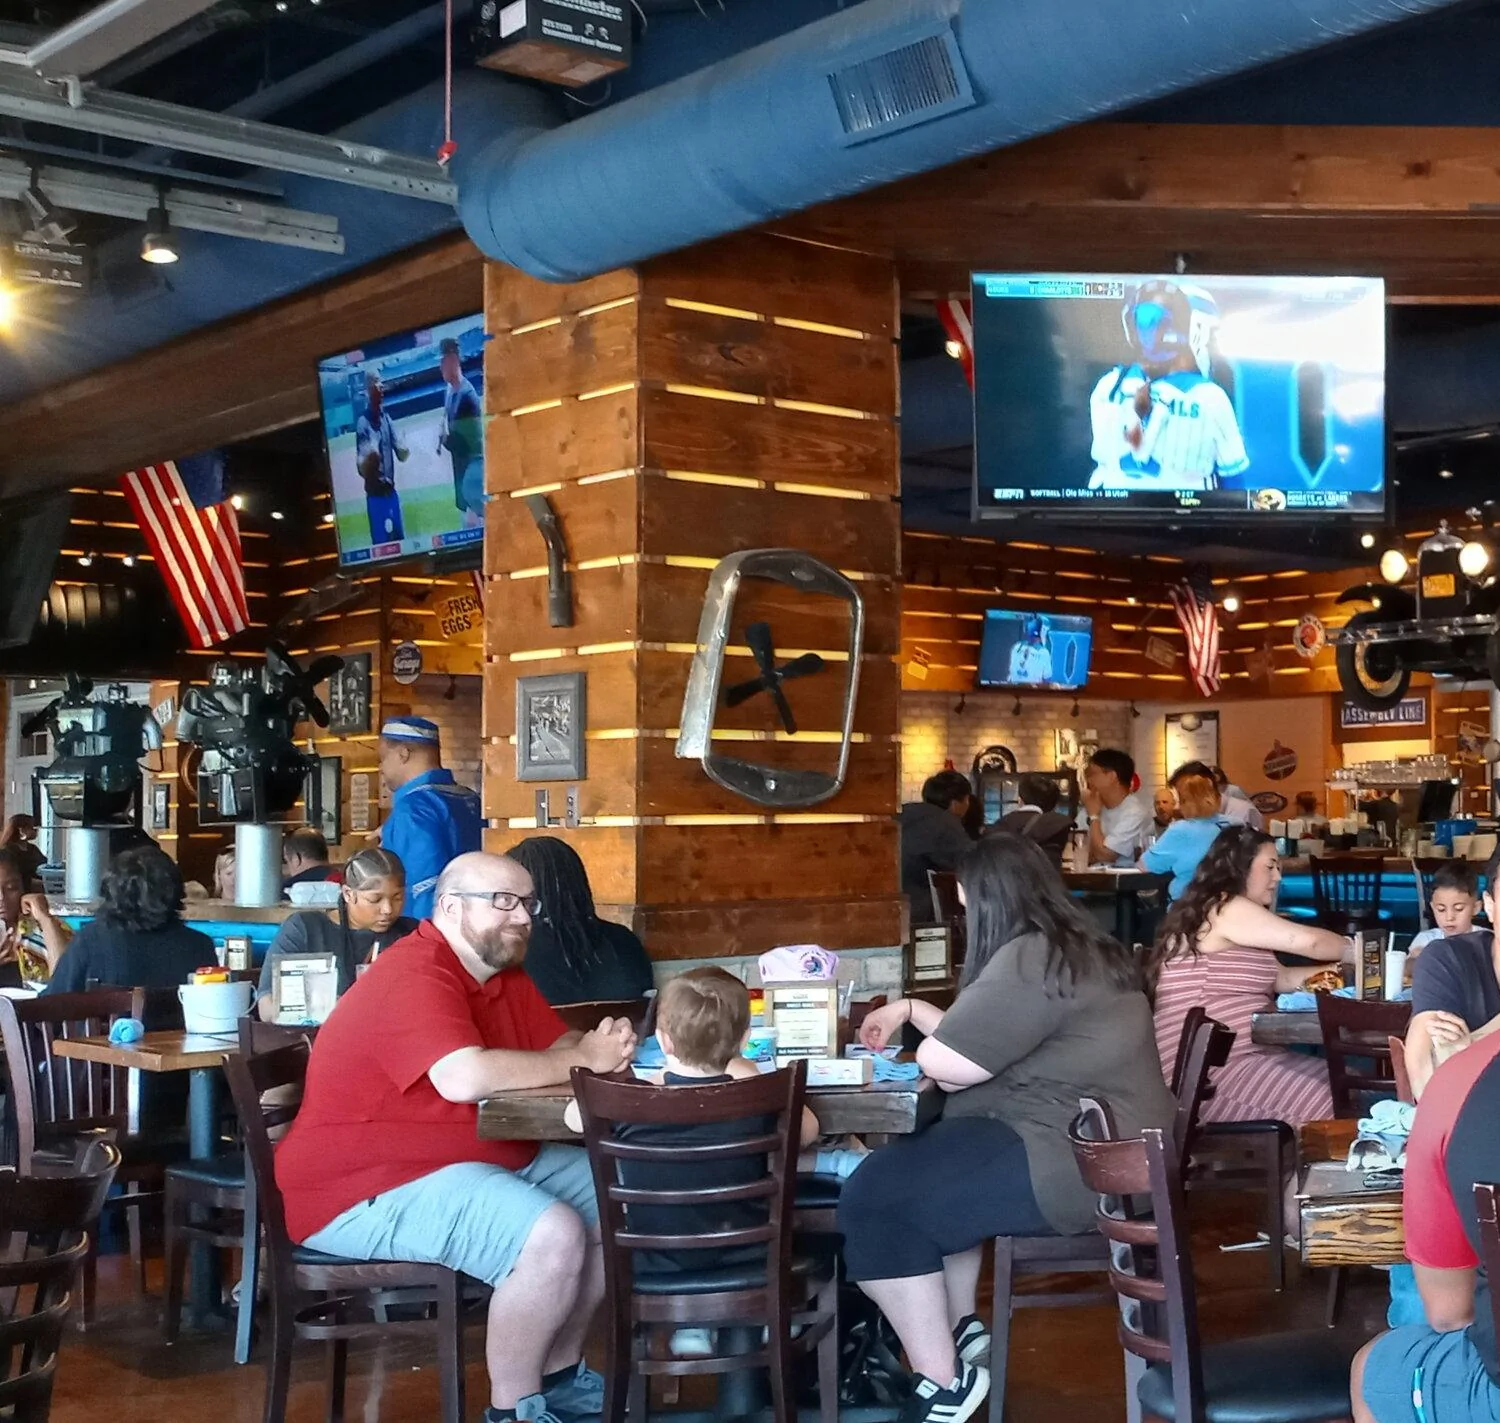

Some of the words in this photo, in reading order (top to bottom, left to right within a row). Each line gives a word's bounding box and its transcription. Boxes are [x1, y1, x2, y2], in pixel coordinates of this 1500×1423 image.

[448, 595, 479, 617] FRESH
[441, 614, 472, 636] EGGS
[1345, 706, 1395, 722] ASSEMBLY
[1399, 705, 1422, 720] LINE
